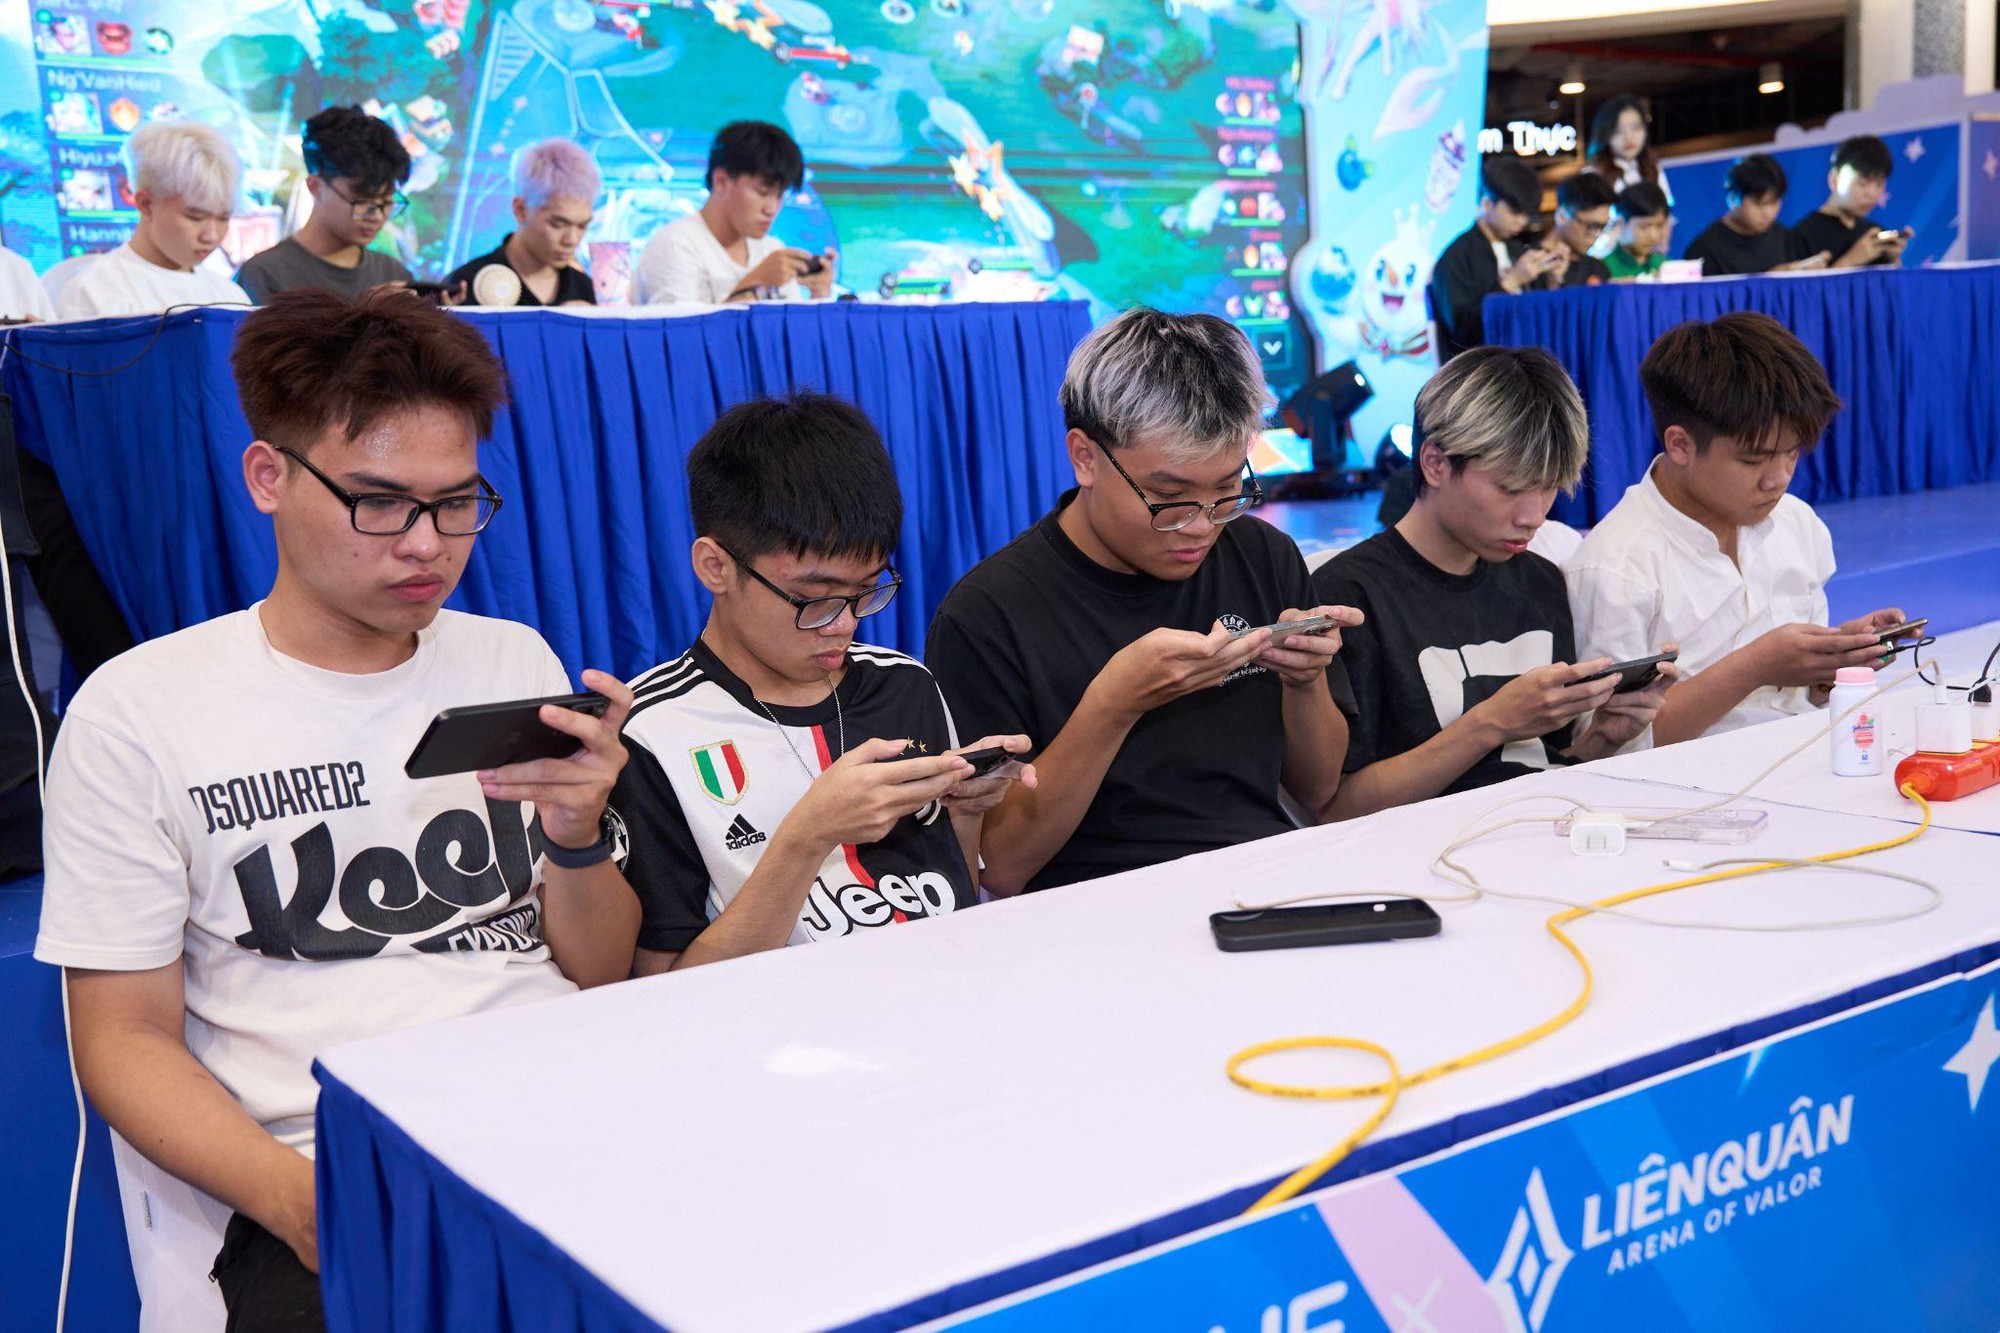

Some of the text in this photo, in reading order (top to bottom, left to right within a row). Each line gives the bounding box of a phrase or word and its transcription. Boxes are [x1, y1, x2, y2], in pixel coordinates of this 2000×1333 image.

[1477, 128, 1503, 153] m
[188, 760, 371, 835] DSQUARED2
[801, 870, 956, 942] Jeep
[1607, 1165, 1822, 1276] ARENA OF VALOR
